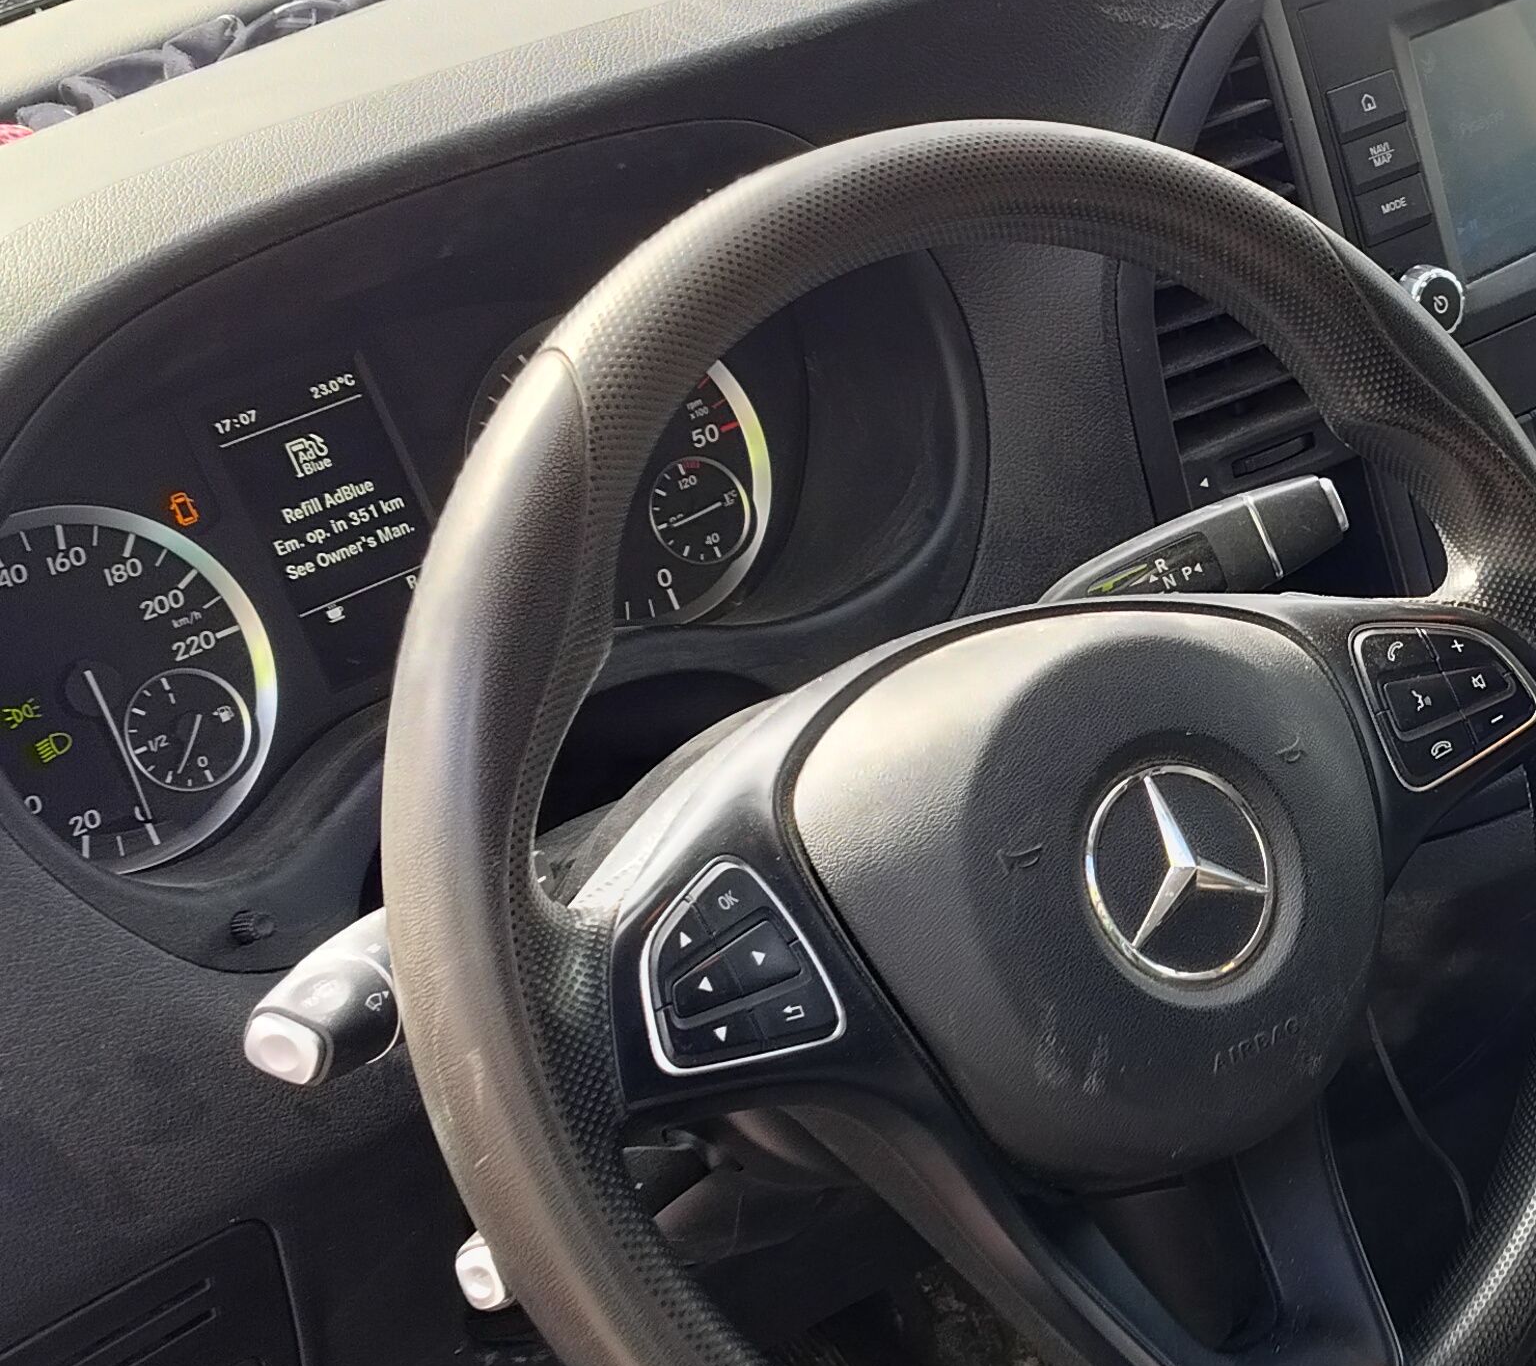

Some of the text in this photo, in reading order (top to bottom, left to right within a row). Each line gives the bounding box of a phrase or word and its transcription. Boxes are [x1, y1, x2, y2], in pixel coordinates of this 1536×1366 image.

[1369, 141, 1391, 156] NAVI
[1372, 153, 1393, 168] MAP
[1380, 196, 1408, 215] MODE
[309, 373, 356, 399] 23.0°C
[214, 409, 257, 434] 17:07
[691, 423, 720, 448] 50
[302, 457, 333, 476] Blue
[678, 474, 698, 490] 120
[281, 480, 375, 524] Refill AdBlue
[273, 496, 405, 557] Em. op. in 351 km
[704, 532, 721, 546] 40
[46, 546, 87, 575] 160
[285, 522, 415, 580] See Owner's Man.
[0, 564, 28, 587] 40
[103, 558, 143, 587] 180
[1154, 558, 1169, 574] R
[657, 568, 673, 588] 0
[1162, 566, 1192, 590] N P
[139, 588, 185, 621] 200
[172, 610, 203, 629] km/h
[172, 630, 216, 662] 220
[197, 755, 209, 768] 0
[69, 809, 101, 837] 20
[717, 889, 739, 910] OK
